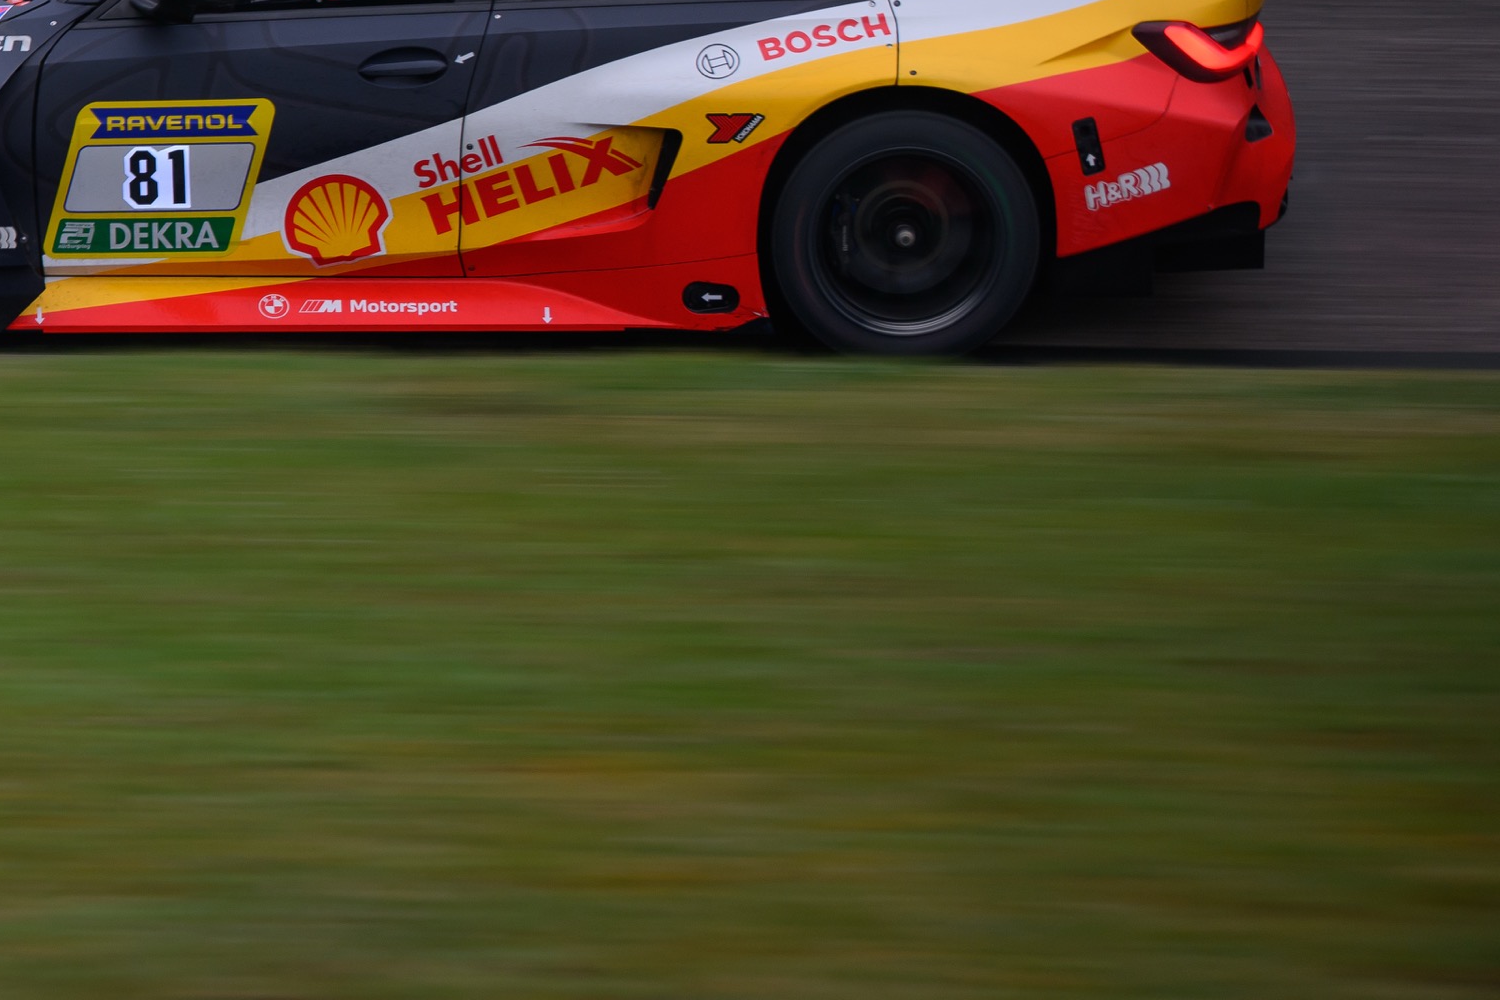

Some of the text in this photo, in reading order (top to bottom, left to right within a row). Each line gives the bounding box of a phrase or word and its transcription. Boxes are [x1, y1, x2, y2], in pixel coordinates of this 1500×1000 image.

[757, 12, 891, 61] BOSCH
[106, 114, 243, 132] RAVENOL
[129, 149, 186, 206] 81
[414, 134, 504, 188] Shell
[420, 136, 644, 236] HELIX
[1084, 172, 1143, 211] H&R
[109, 220, 219, 250] DEKRA
[350, 299, 458, 316] Motorsport
